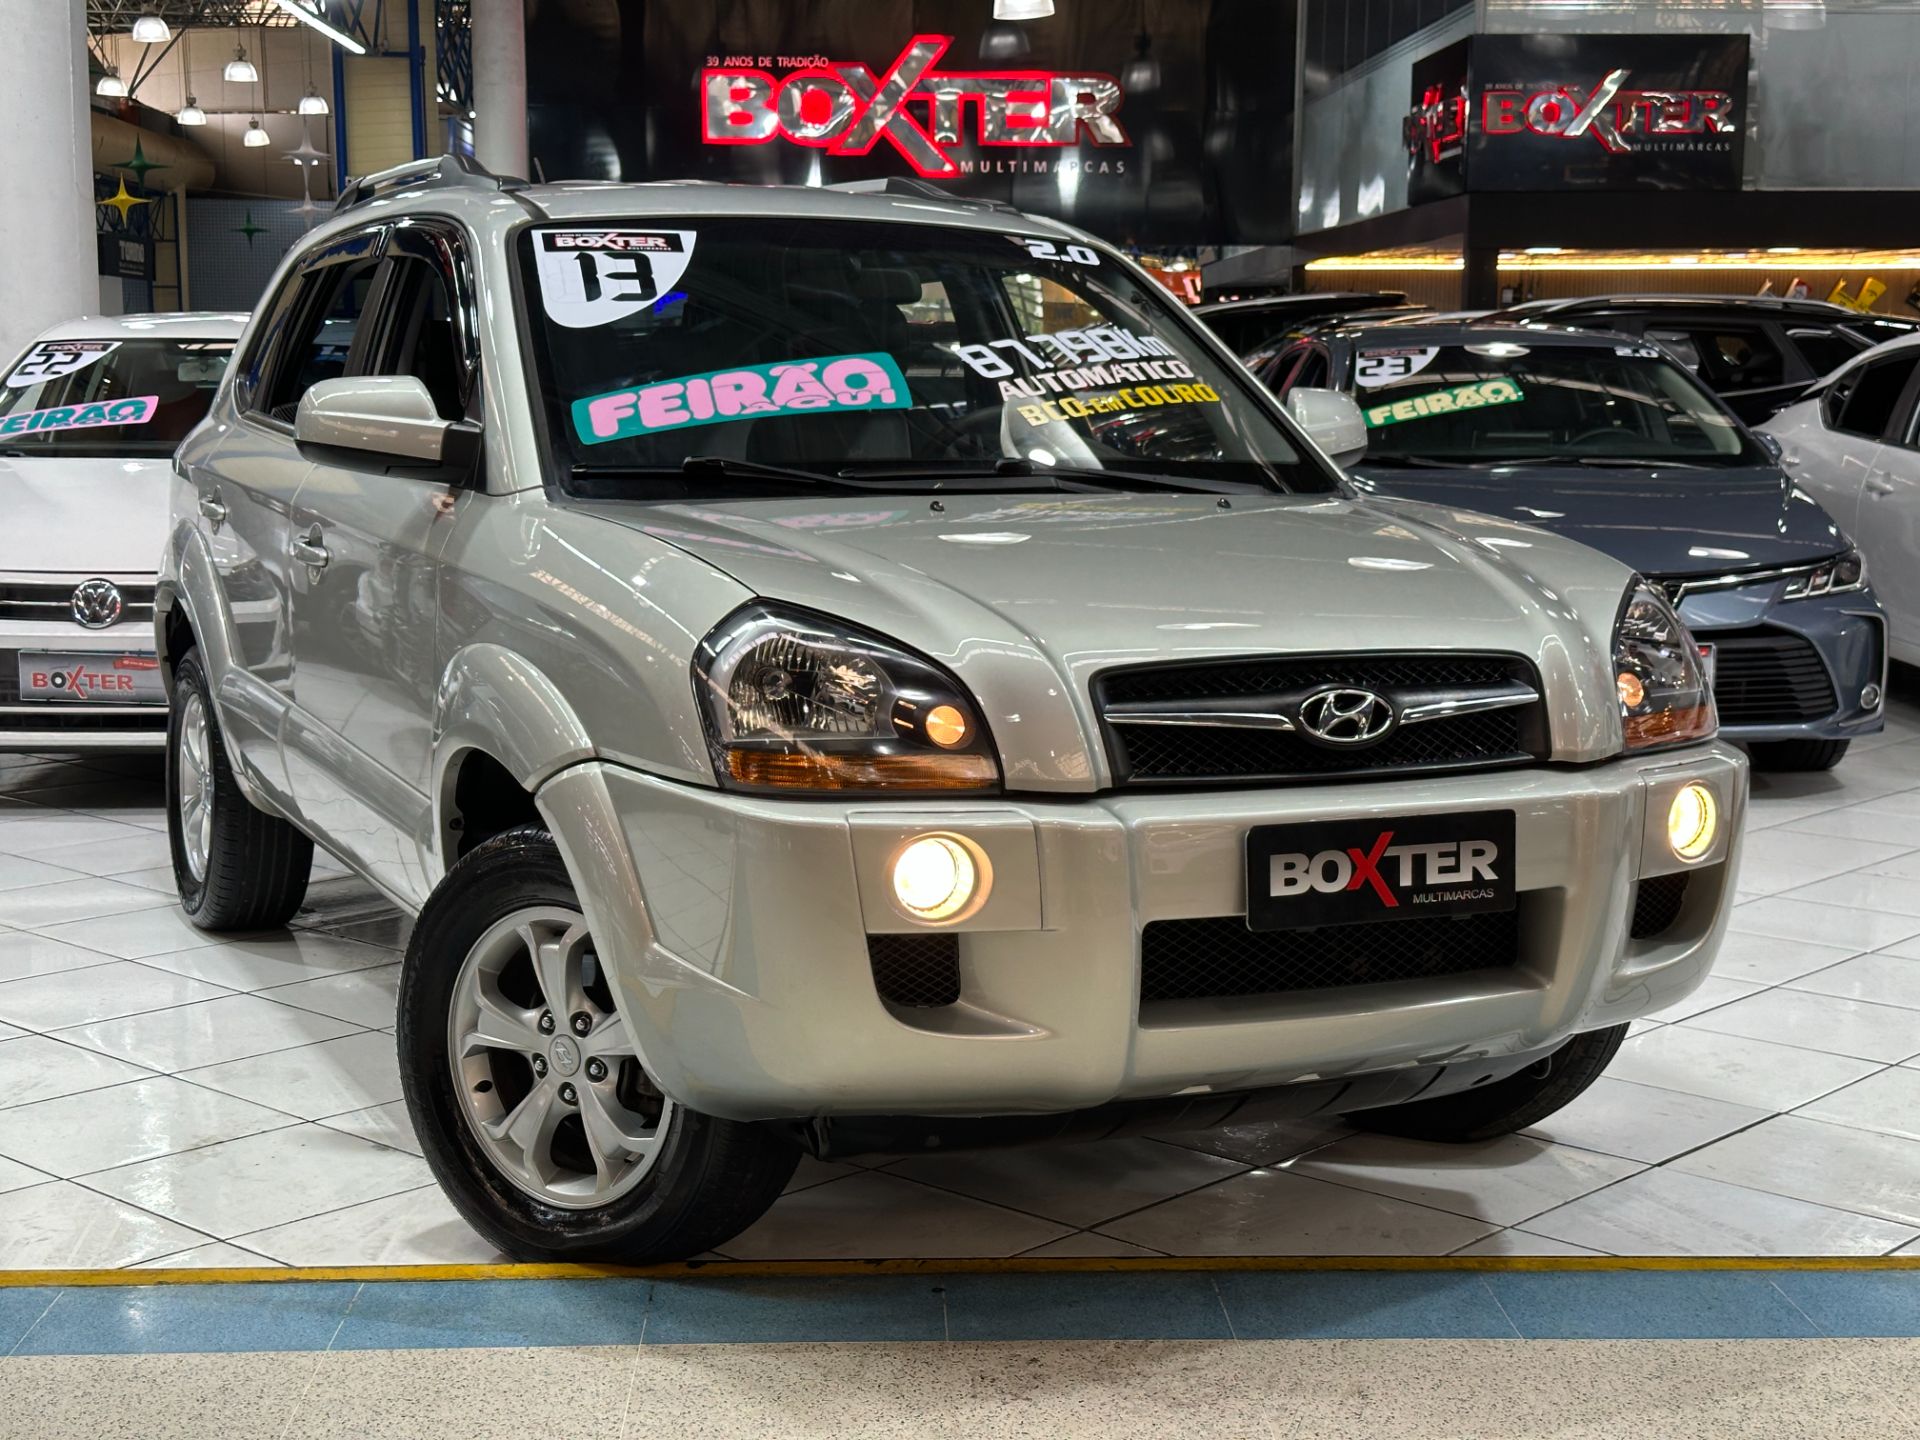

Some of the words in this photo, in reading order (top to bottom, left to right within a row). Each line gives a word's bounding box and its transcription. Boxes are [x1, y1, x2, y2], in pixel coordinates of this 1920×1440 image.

[706, 56, 719, 67] 39
[723, 56, 754, 67] ANOS
[758, 57, 772, 67] DE
[777, 54, 829, 68] TRADIÇÃO
[702, 34, 1133, 178] BOXTER
[1483, 68, 1735, 153] BOXTER
[1632, 143, 1730, 152] MULTIMARCAS
[960, 160, 1125, 173] MULTIMARCAS
[555, 233, 668, 250] BOXTER
[1025, 239, 1100, 266] 2.0
[573, 252, 658, 302] 13
[15, 352, 83, 376] 22
[1359, 356, 1412, 377] 23
[588, 358, 891, 437] FEIRÃO
[1119, 384, 1220, 409] COURO
[1369, 382, 1515, 425] FEIRÃO
[0, 400, 148, 435] EIRÃO
[32, 665, 134, 699] BOXTER
[1270, 831, 1499, 907] BOXTER
[1413, 888, 1495, 904] MULTIMARCAS
